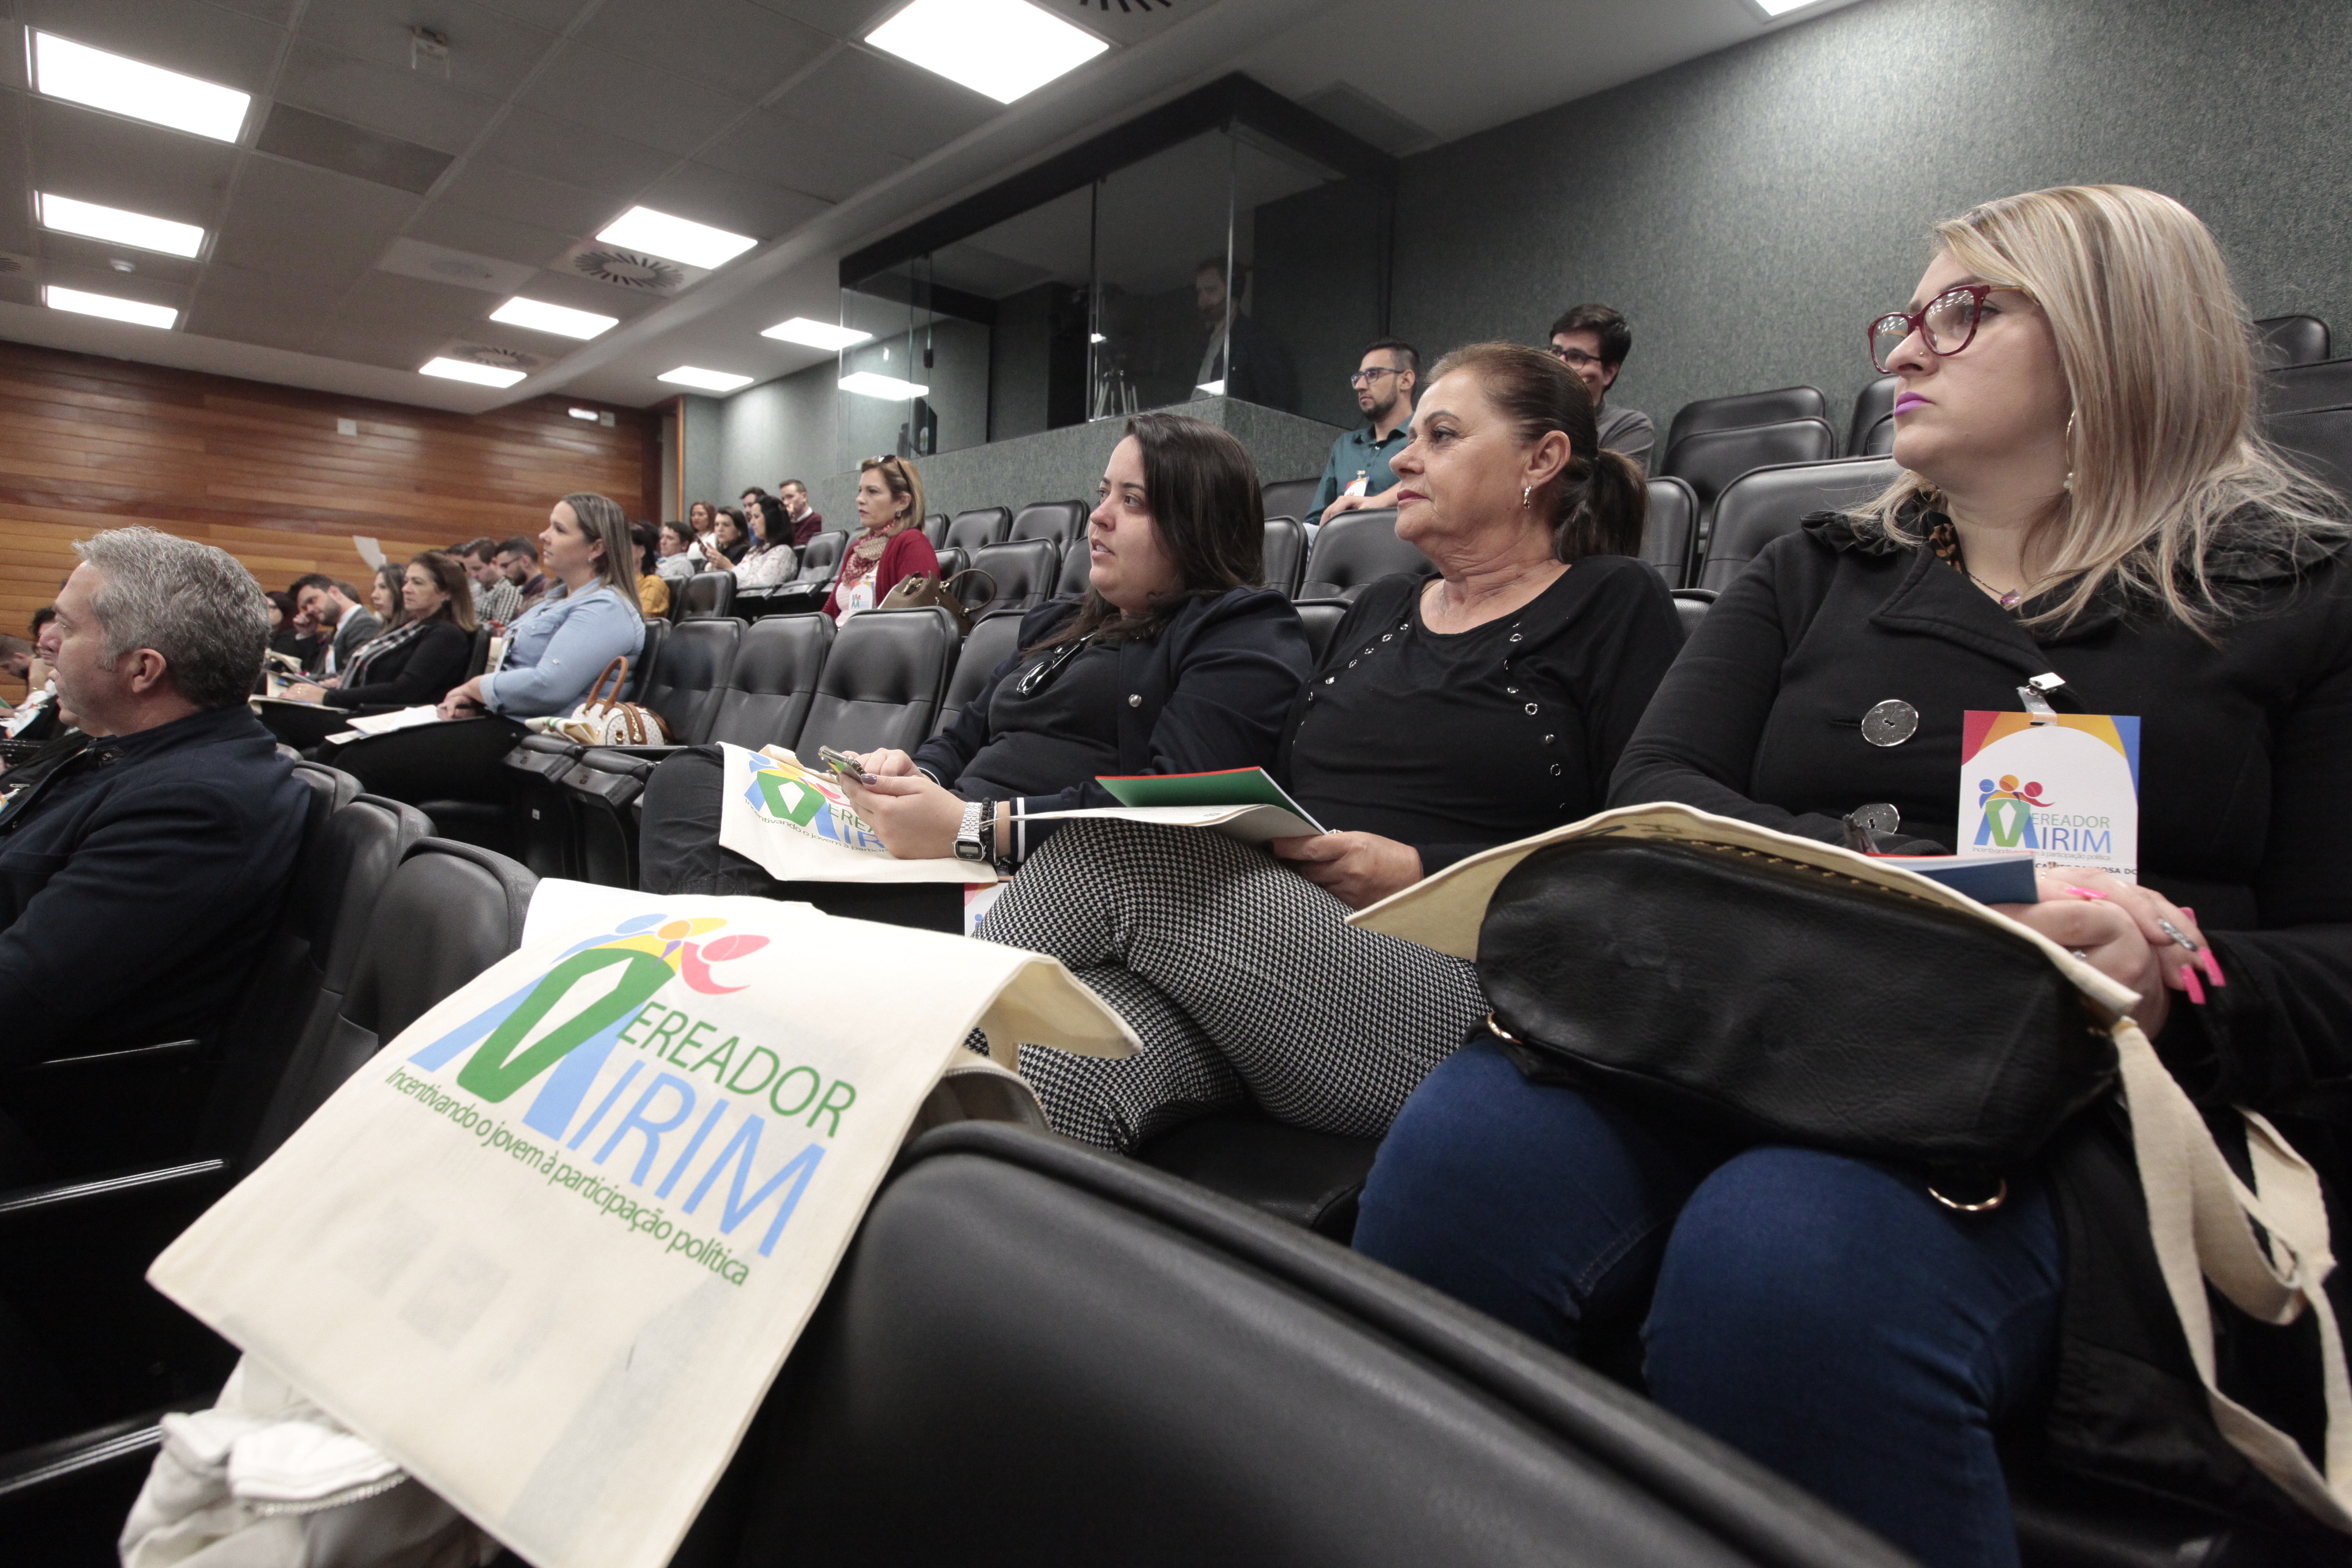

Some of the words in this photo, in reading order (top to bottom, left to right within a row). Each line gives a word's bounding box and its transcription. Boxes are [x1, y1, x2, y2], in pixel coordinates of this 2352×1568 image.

[745, 798, 801, 832] Incentivando
[811, 833, 842, 846] jovem
[385, 1065, 478, 1128] Incentivando
[475, 1119, 493, 1137] o
[480, 1120, 545, 1167] jovem
[540, 1150, 560, 1174] à
[547, 1163, 673, 1240] participação
[665, 1229, 750, 1286] política
